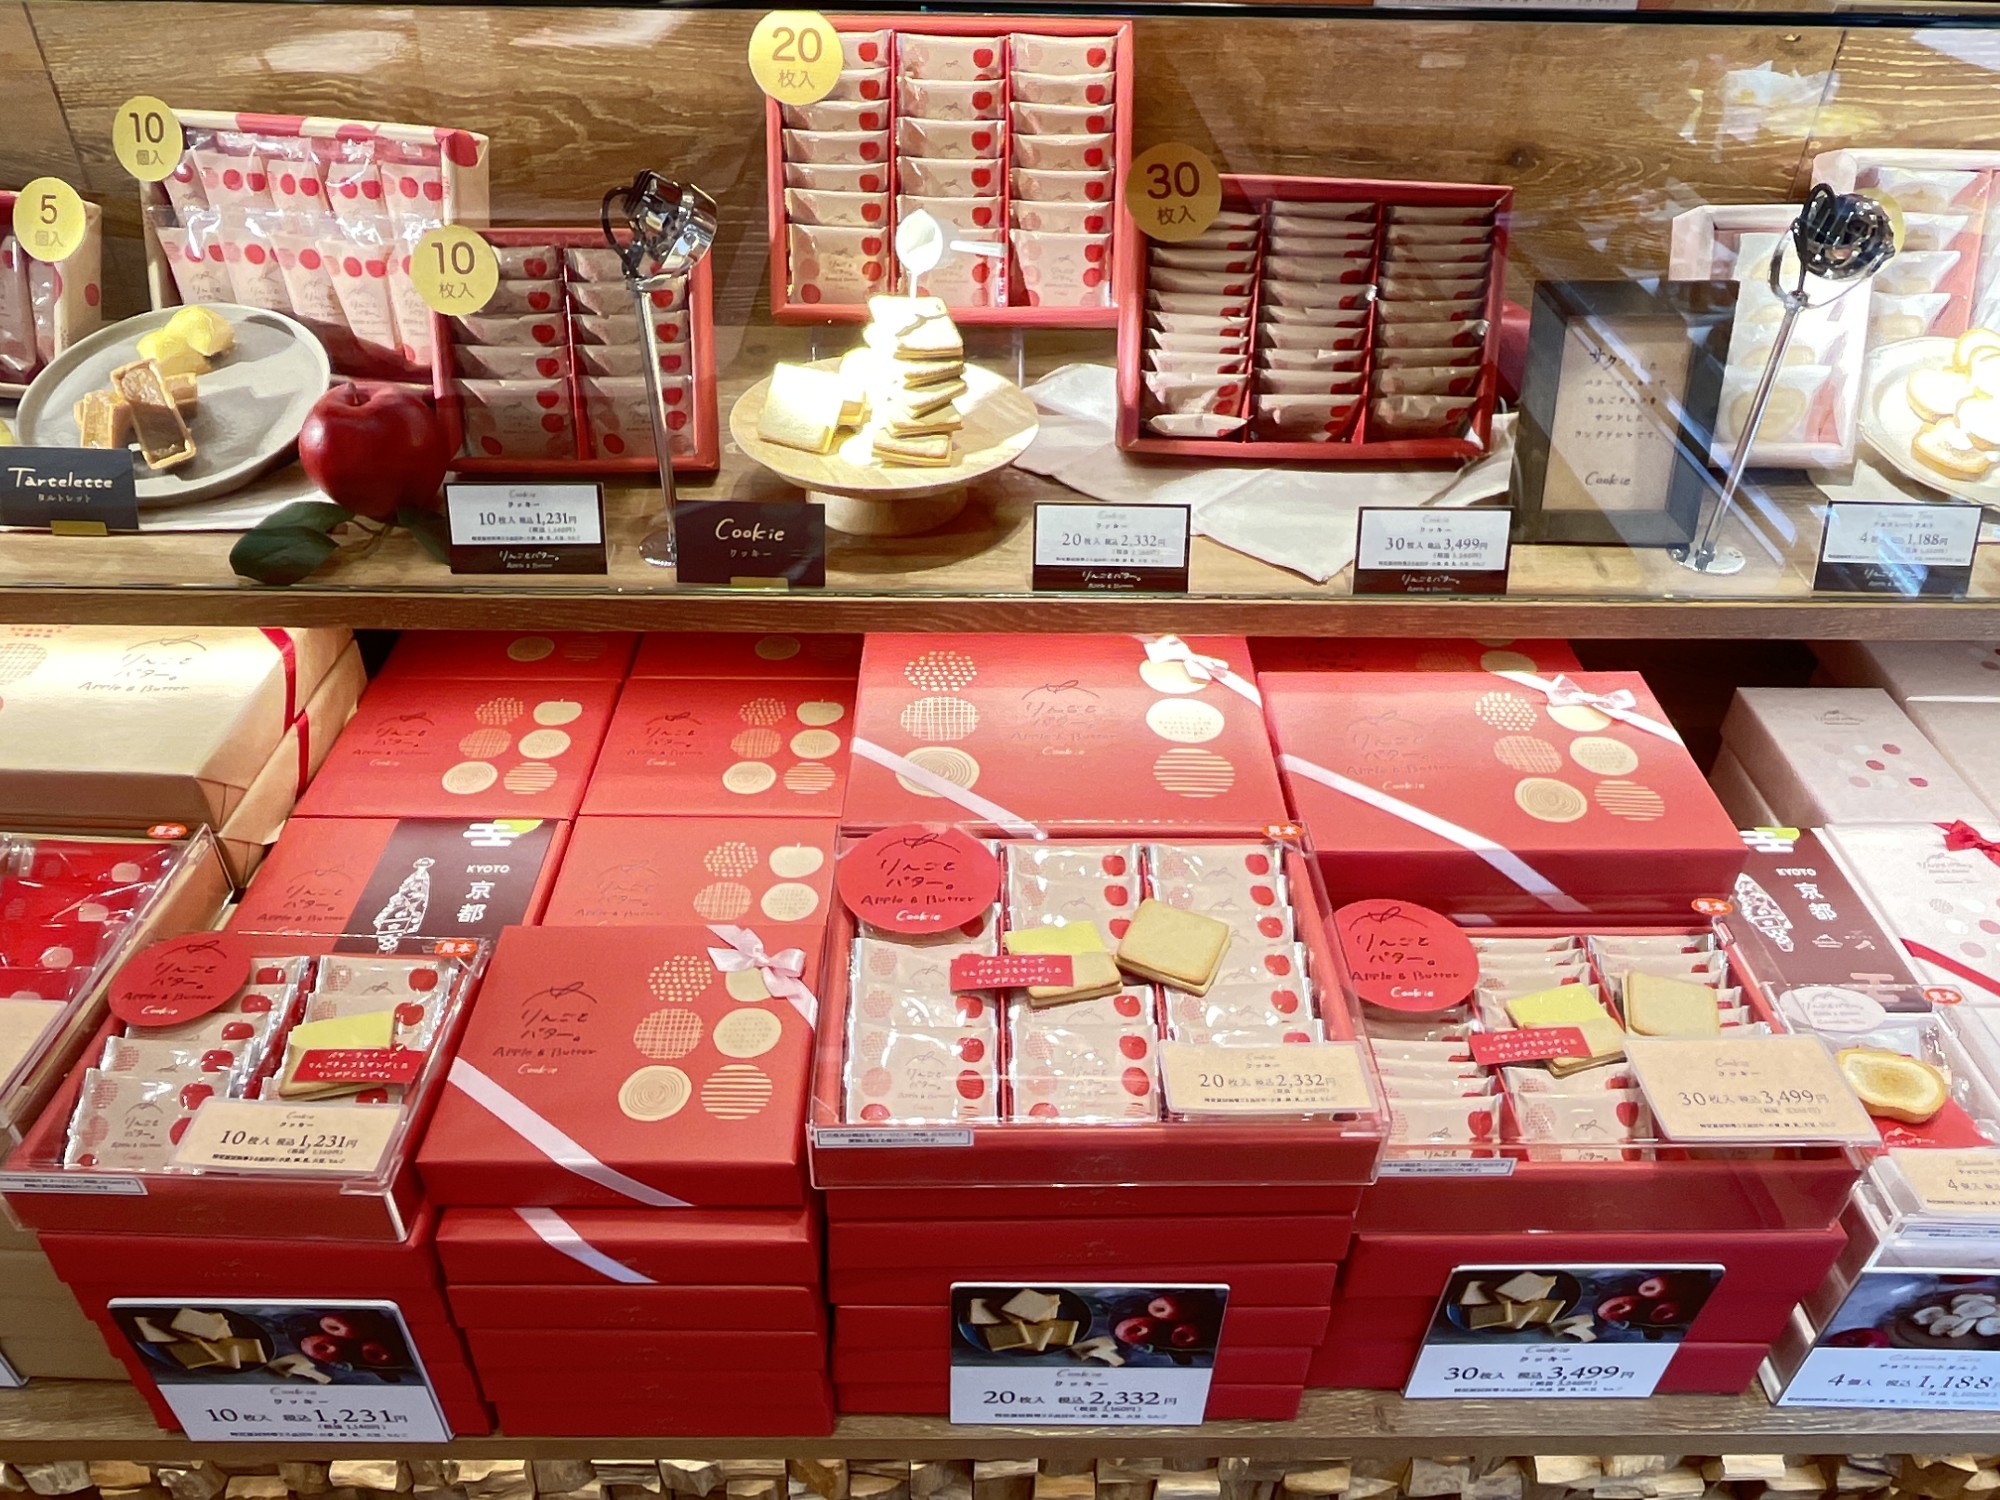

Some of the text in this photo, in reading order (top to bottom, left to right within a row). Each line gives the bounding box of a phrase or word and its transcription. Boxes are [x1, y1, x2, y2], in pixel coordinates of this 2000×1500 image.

[771, 26, 823, 63] 20
[778, 69, 816, 90] 枚入
[129, 112, 164, 144] 10
[136, 149, 164, 167] 個入
[1147, 161, 1201, 199] 30
[40, 195, 58, 223] 5
[1157, 205, 1196, 225] 枚入
[34, 230, 64, 248] 個入
[431, 241, 475, 275] 10
[439, 283, 474, 299] 枚入
[8, 467, 113, 489] Tartelette
[1585, 471, 1631, 486] Cookie
[715, 518, 785, 543] Cookie
[1268, 825, 1297, 836] 見本
[466, 865, 510, 873] KYOTO
[880, 859, 955, 875] りんごと
[1776, 868, 1817, 877] KYOTO
[886, 876, 953, 890] バター。
[457, 881, 495, 923] 京都
[1794, 882, 1837, 920] 京都
[896, 910, 942, 922] Cookie
[439, 942, 473, 953] 見本
[1357, 933, 1431, 951] りんごと
[1370, 953, 1435, 966] バター。
[155, 962, 216, 975] りんごと
[150, 977, 204, 989] バター。
[1390, 987, 1435, 998] Cookie
[141, 1005, 178, 1015] Cookie
[520, 1008, 589, 1027] りんごと
[520, 1028, 581, 1042] バター。
